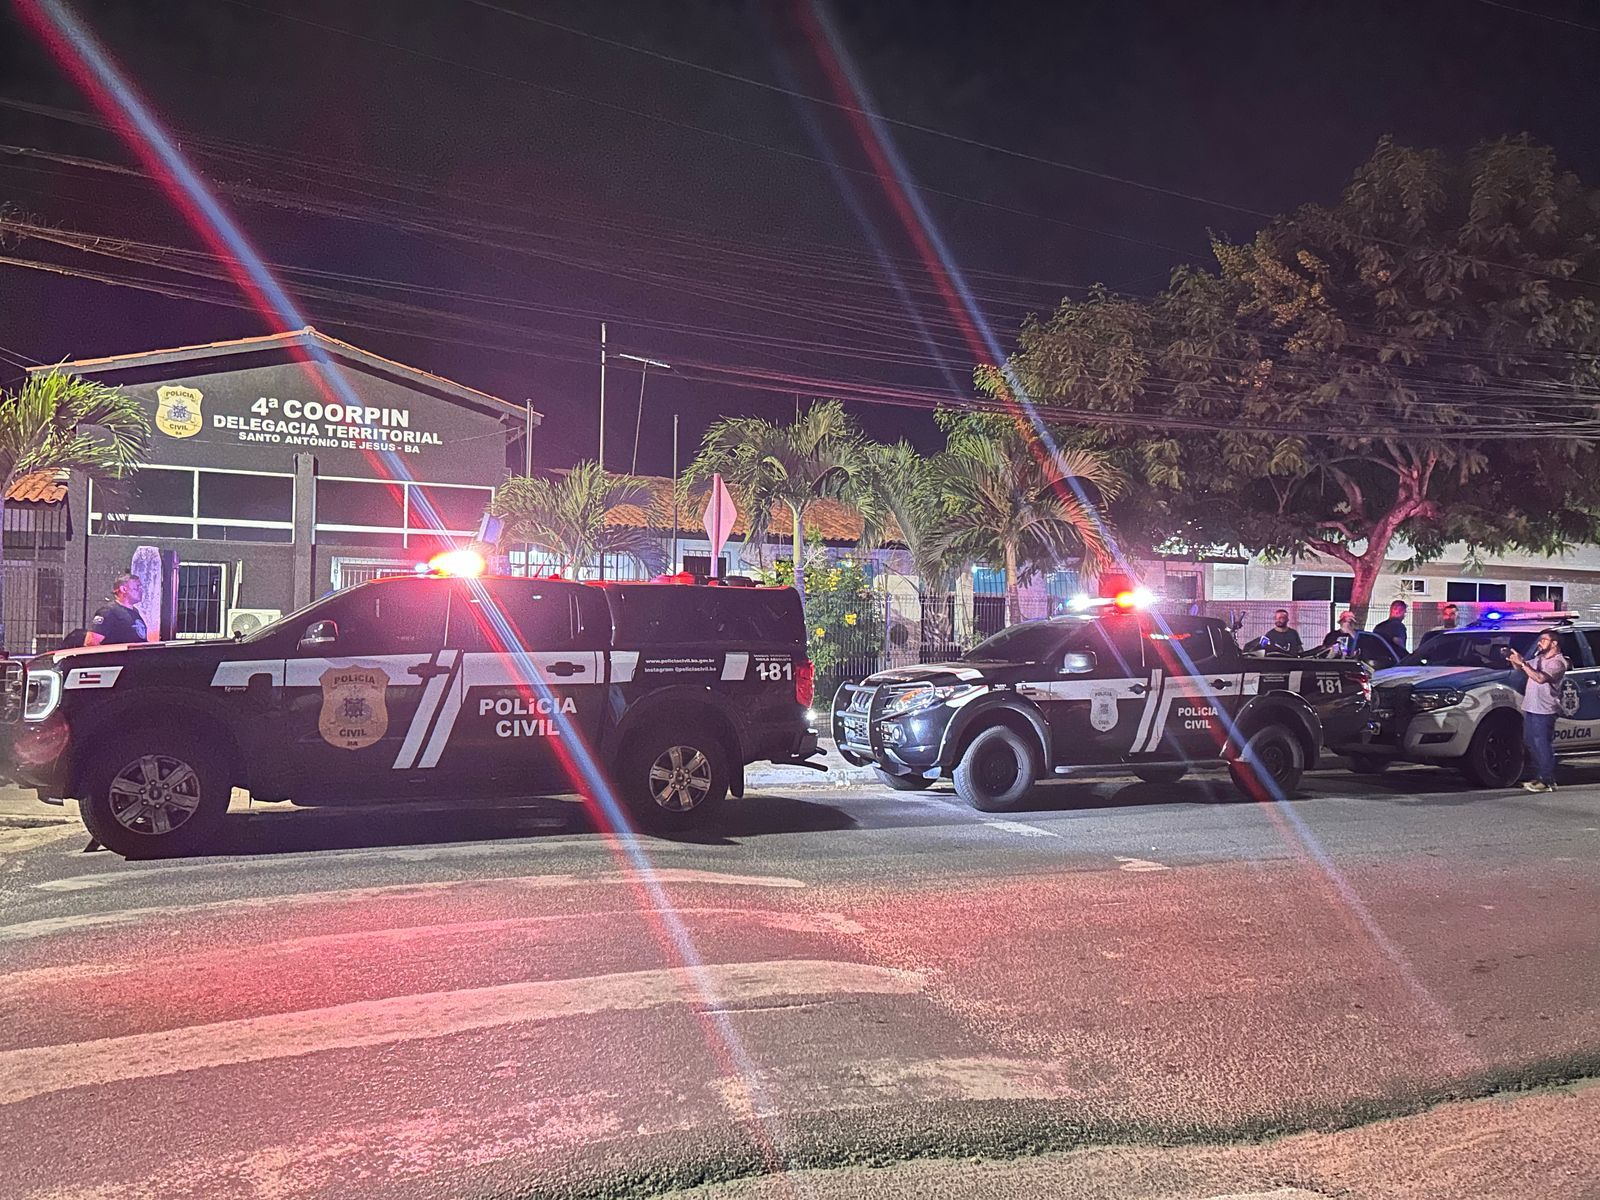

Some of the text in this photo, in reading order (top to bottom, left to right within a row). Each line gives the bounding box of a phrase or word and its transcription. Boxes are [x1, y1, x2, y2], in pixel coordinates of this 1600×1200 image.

[283, 399, 409, 428] COORPIN
[169, 423, 189, 431] CIVIL
[213, 415, 443, 445] DELEGACIA TERRITORIAL
[238, 431, 281, 443] SANTO
[285, 434, 338, 448] ANTÔNIO
[341, 441, 357, 449] DE
[358, 442, 395, 451] JESUS
[404, 444, 420, 453] BA
[756, 662, 792, 680] 181
[1317, 679, 1343, 694] 181
[495, 719, 561, 737] CIVIL
[1184, 719, 1212, 729] CIVIL
[339, 729, 367, 737] CIVIL
[1553, 726, 1592, 740] POLÍCIA
